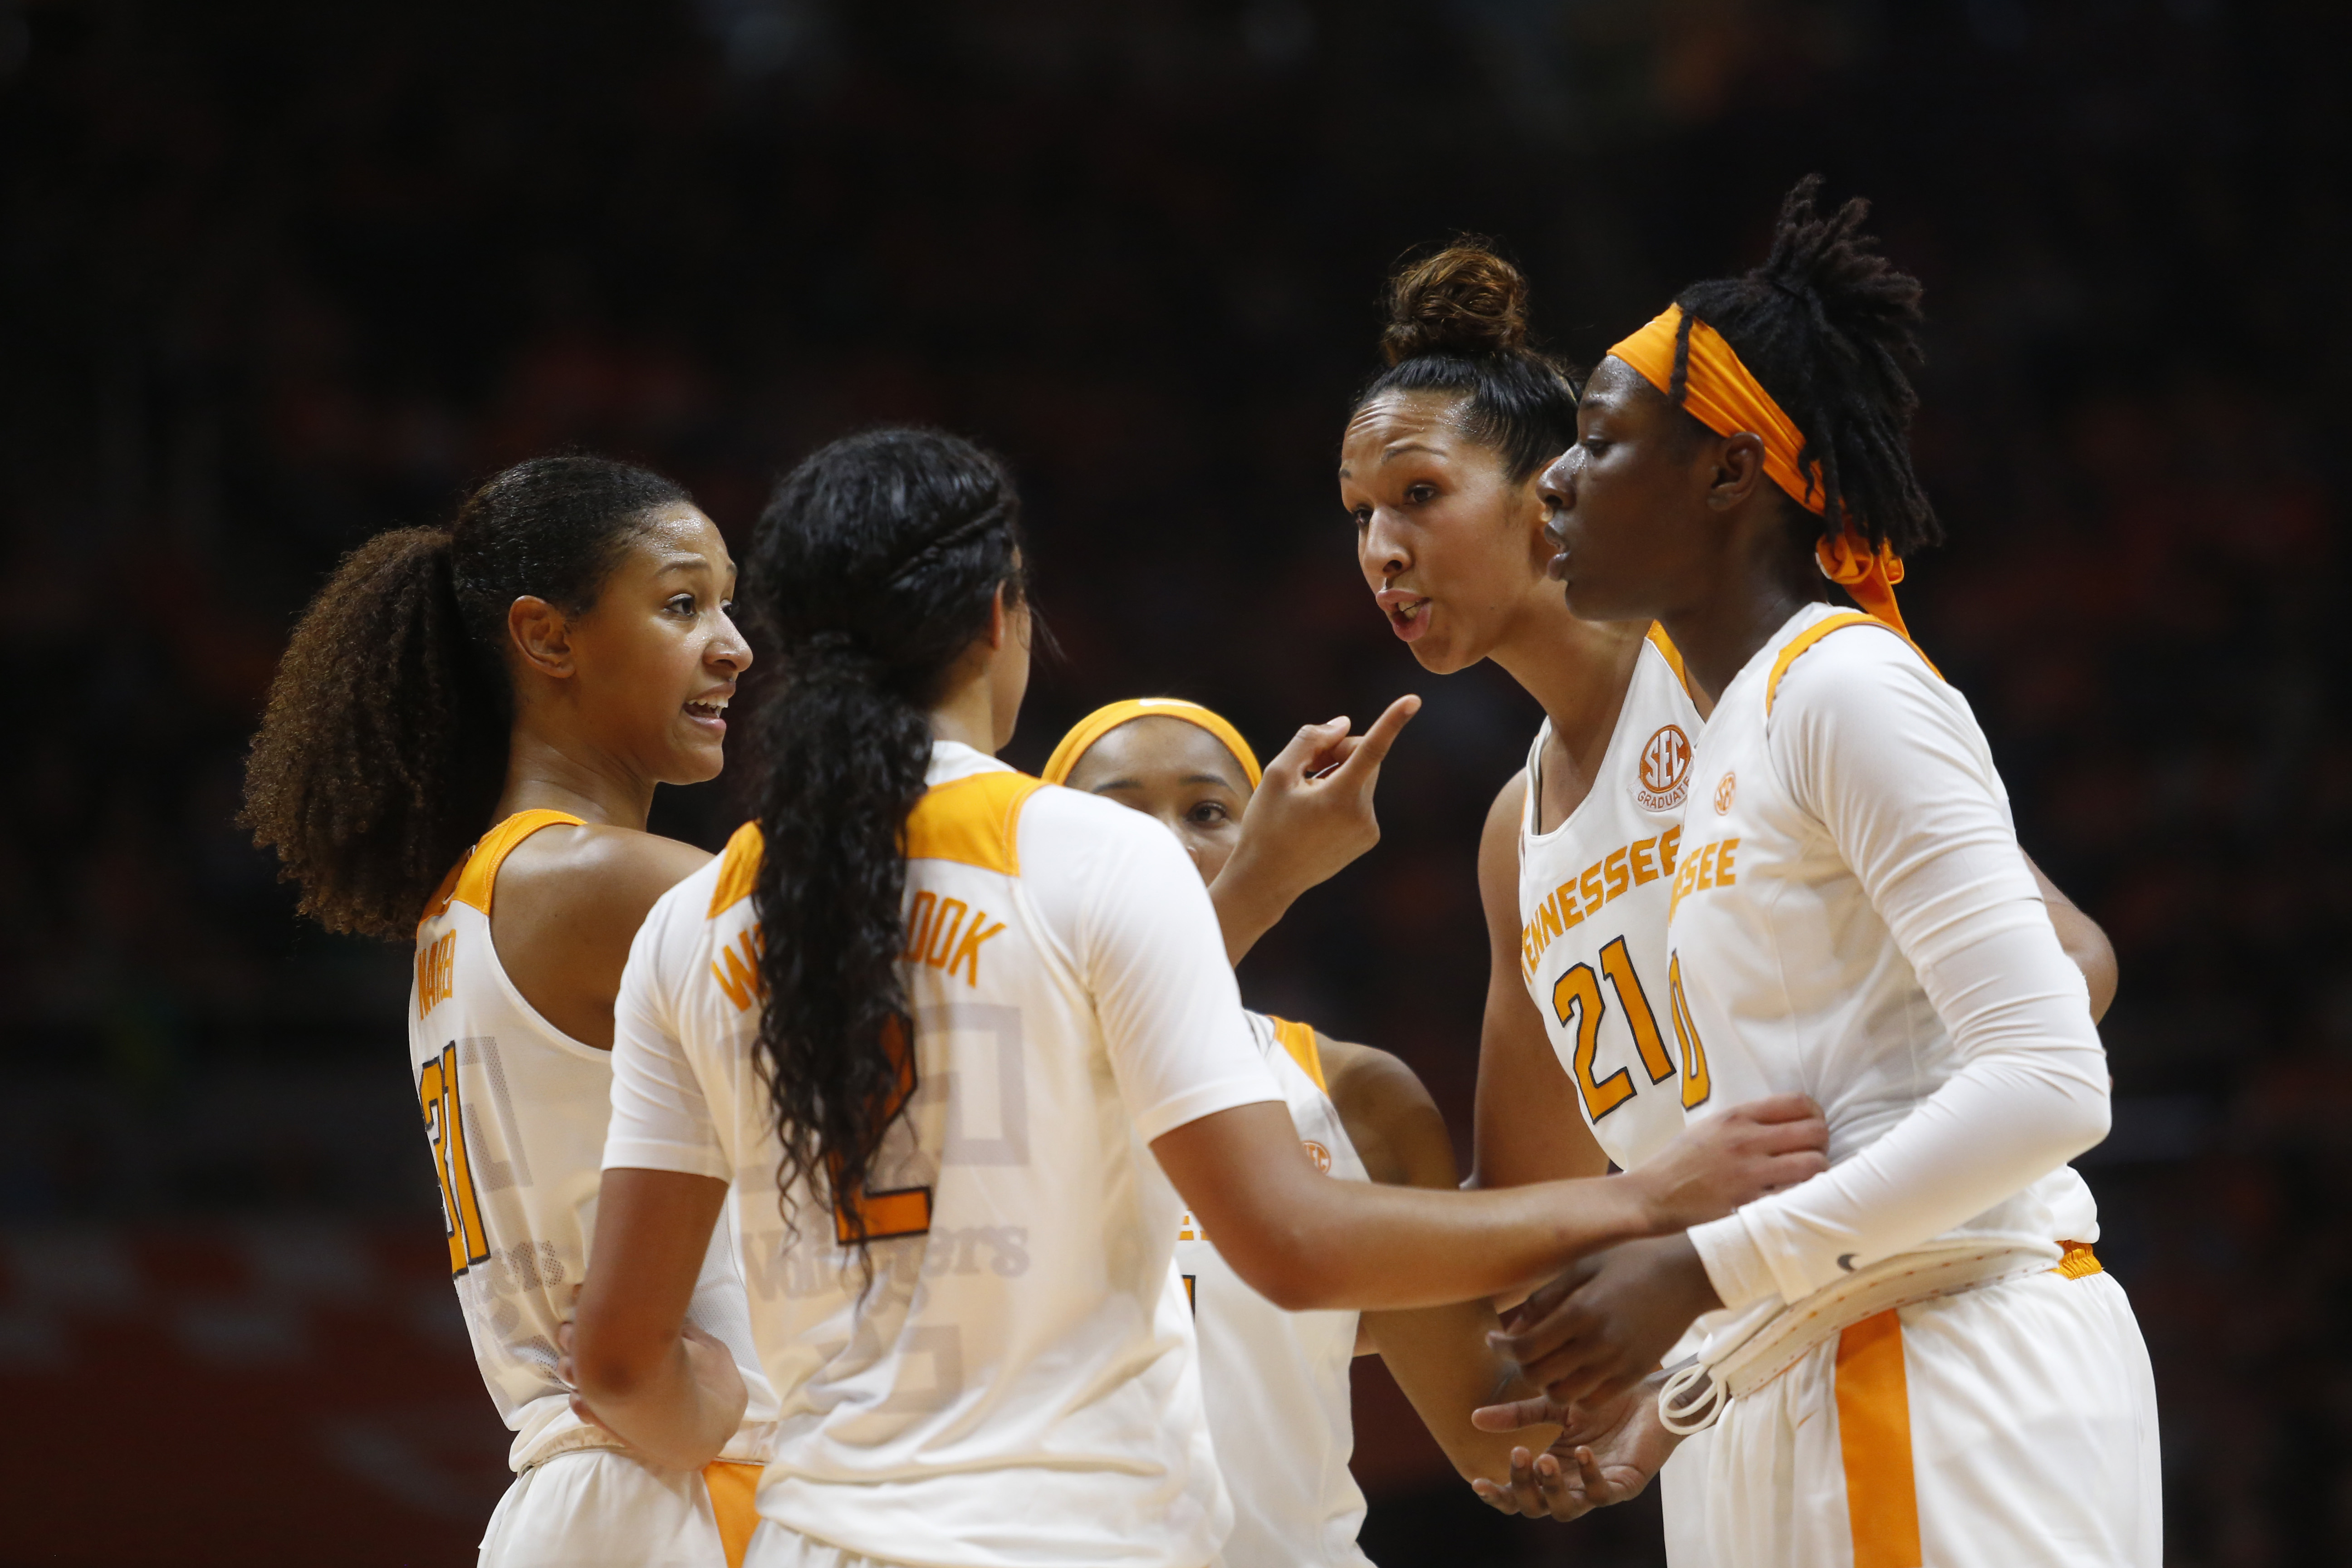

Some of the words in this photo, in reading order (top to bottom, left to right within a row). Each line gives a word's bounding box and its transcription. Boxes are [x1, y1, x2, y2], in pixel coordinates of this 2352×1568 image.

[1645, 730, 1685, 788] SEC
[1637, 776, 1690, 809] GRADUATE
[1552, 935, 1676, 1125] 21
